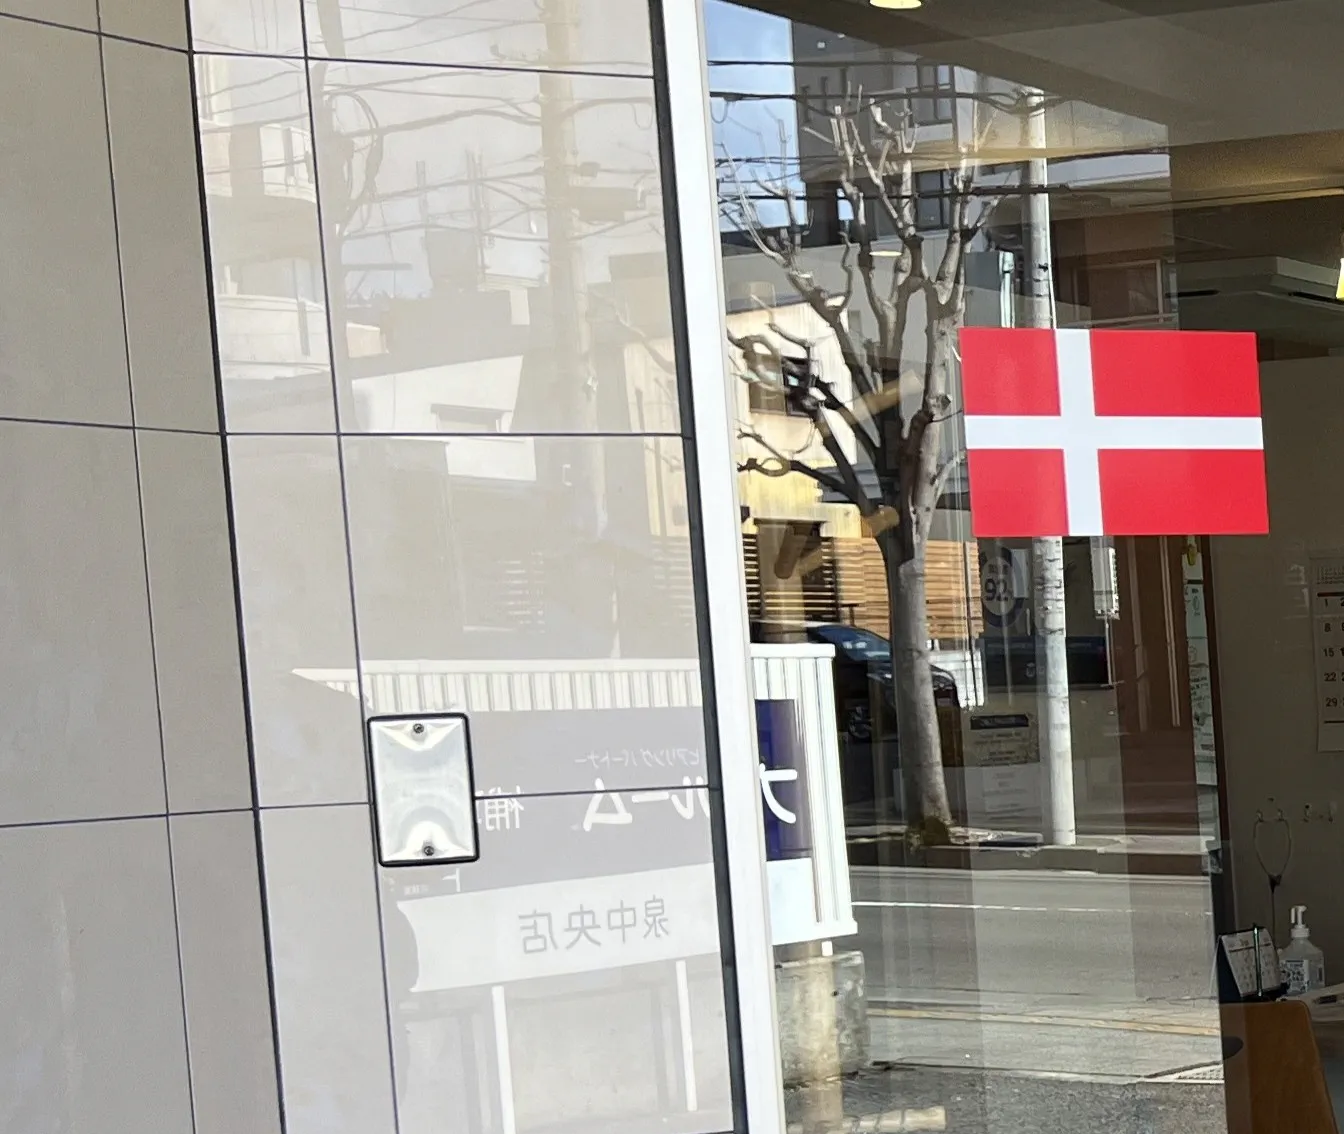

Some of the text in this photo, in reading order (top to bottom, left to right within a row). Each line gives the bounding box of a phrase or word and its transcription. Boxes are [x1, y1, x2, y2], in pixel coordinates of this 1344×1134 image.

[1324, 648, 1334, 657] 15
[1324, 673, 1336, 682] 22
[1326, 698, 1337, 707] 29
